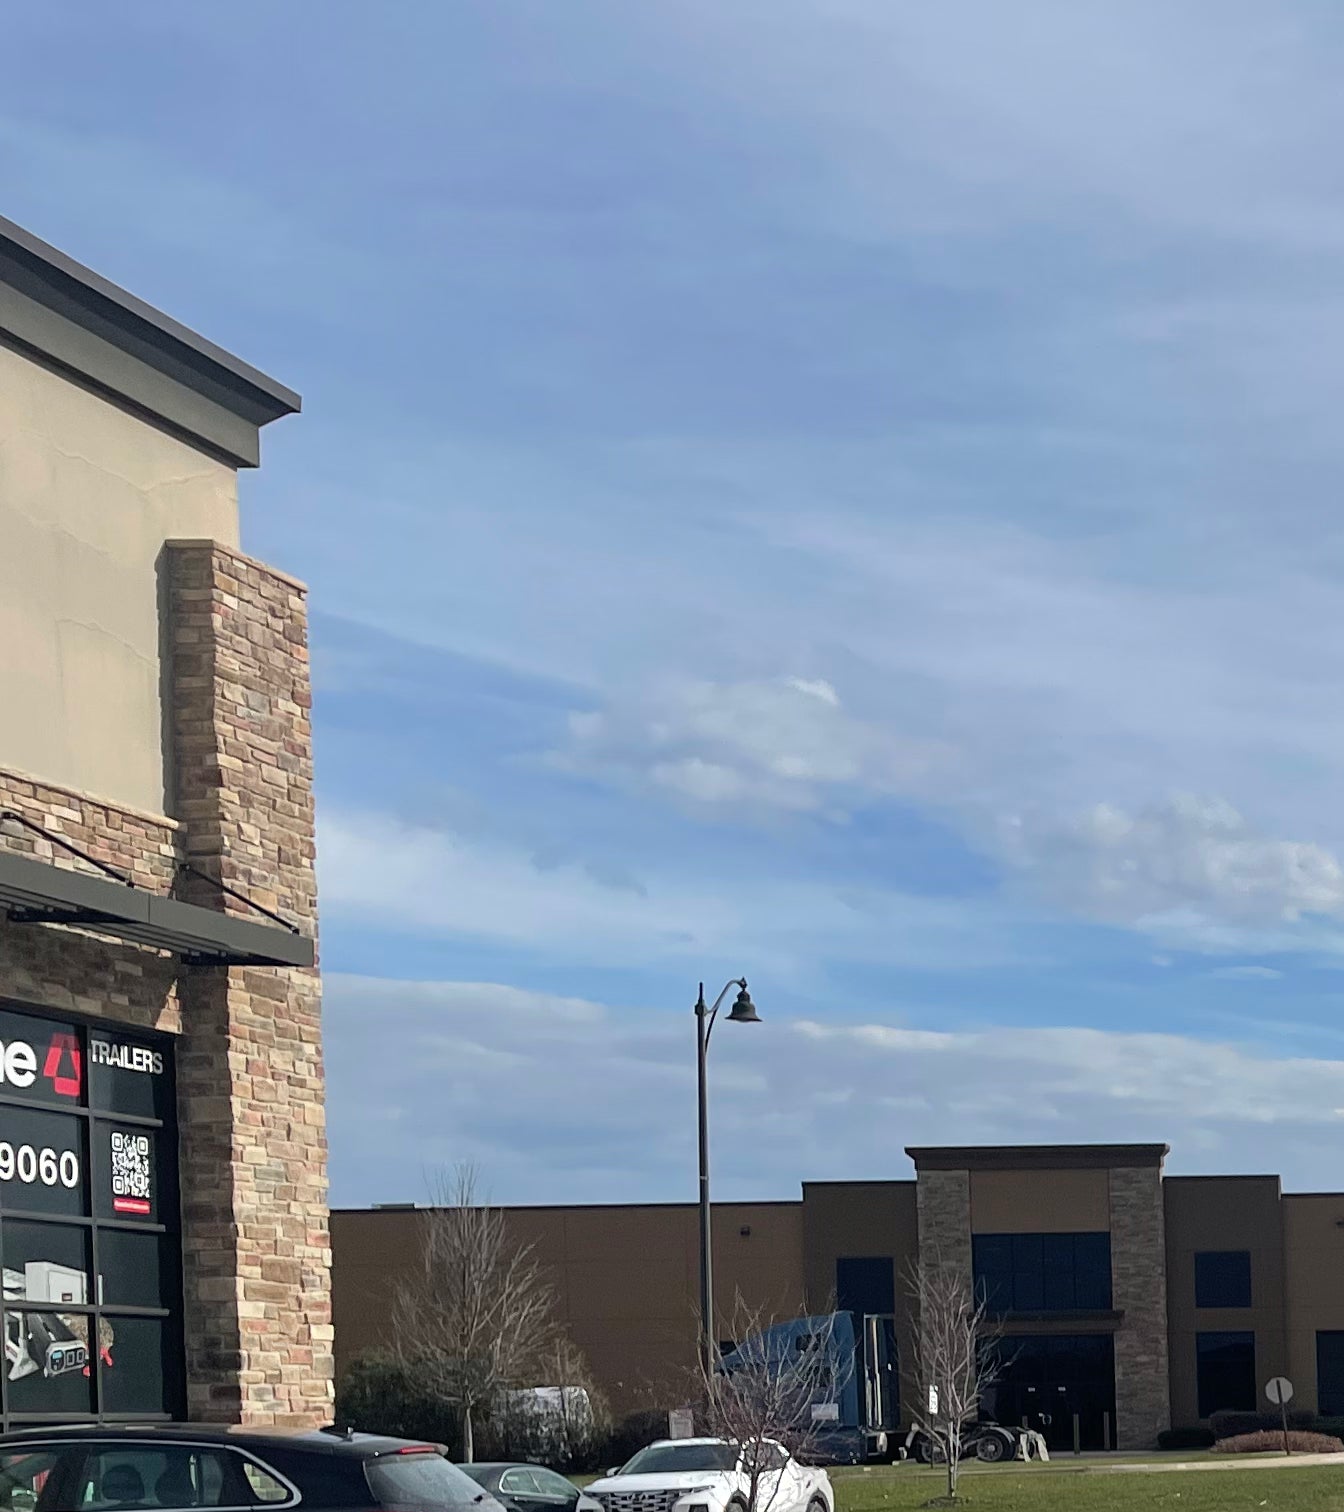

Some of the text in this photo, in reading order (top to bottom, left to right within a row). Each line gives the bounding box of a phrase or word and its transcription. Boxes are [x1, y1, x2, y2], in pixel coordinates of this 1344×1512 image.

[0, 1040, 37, 1088] e
[90, 1039, 164, 1075] TRAILERS
[0, 1141, 79, 1188] 9060
